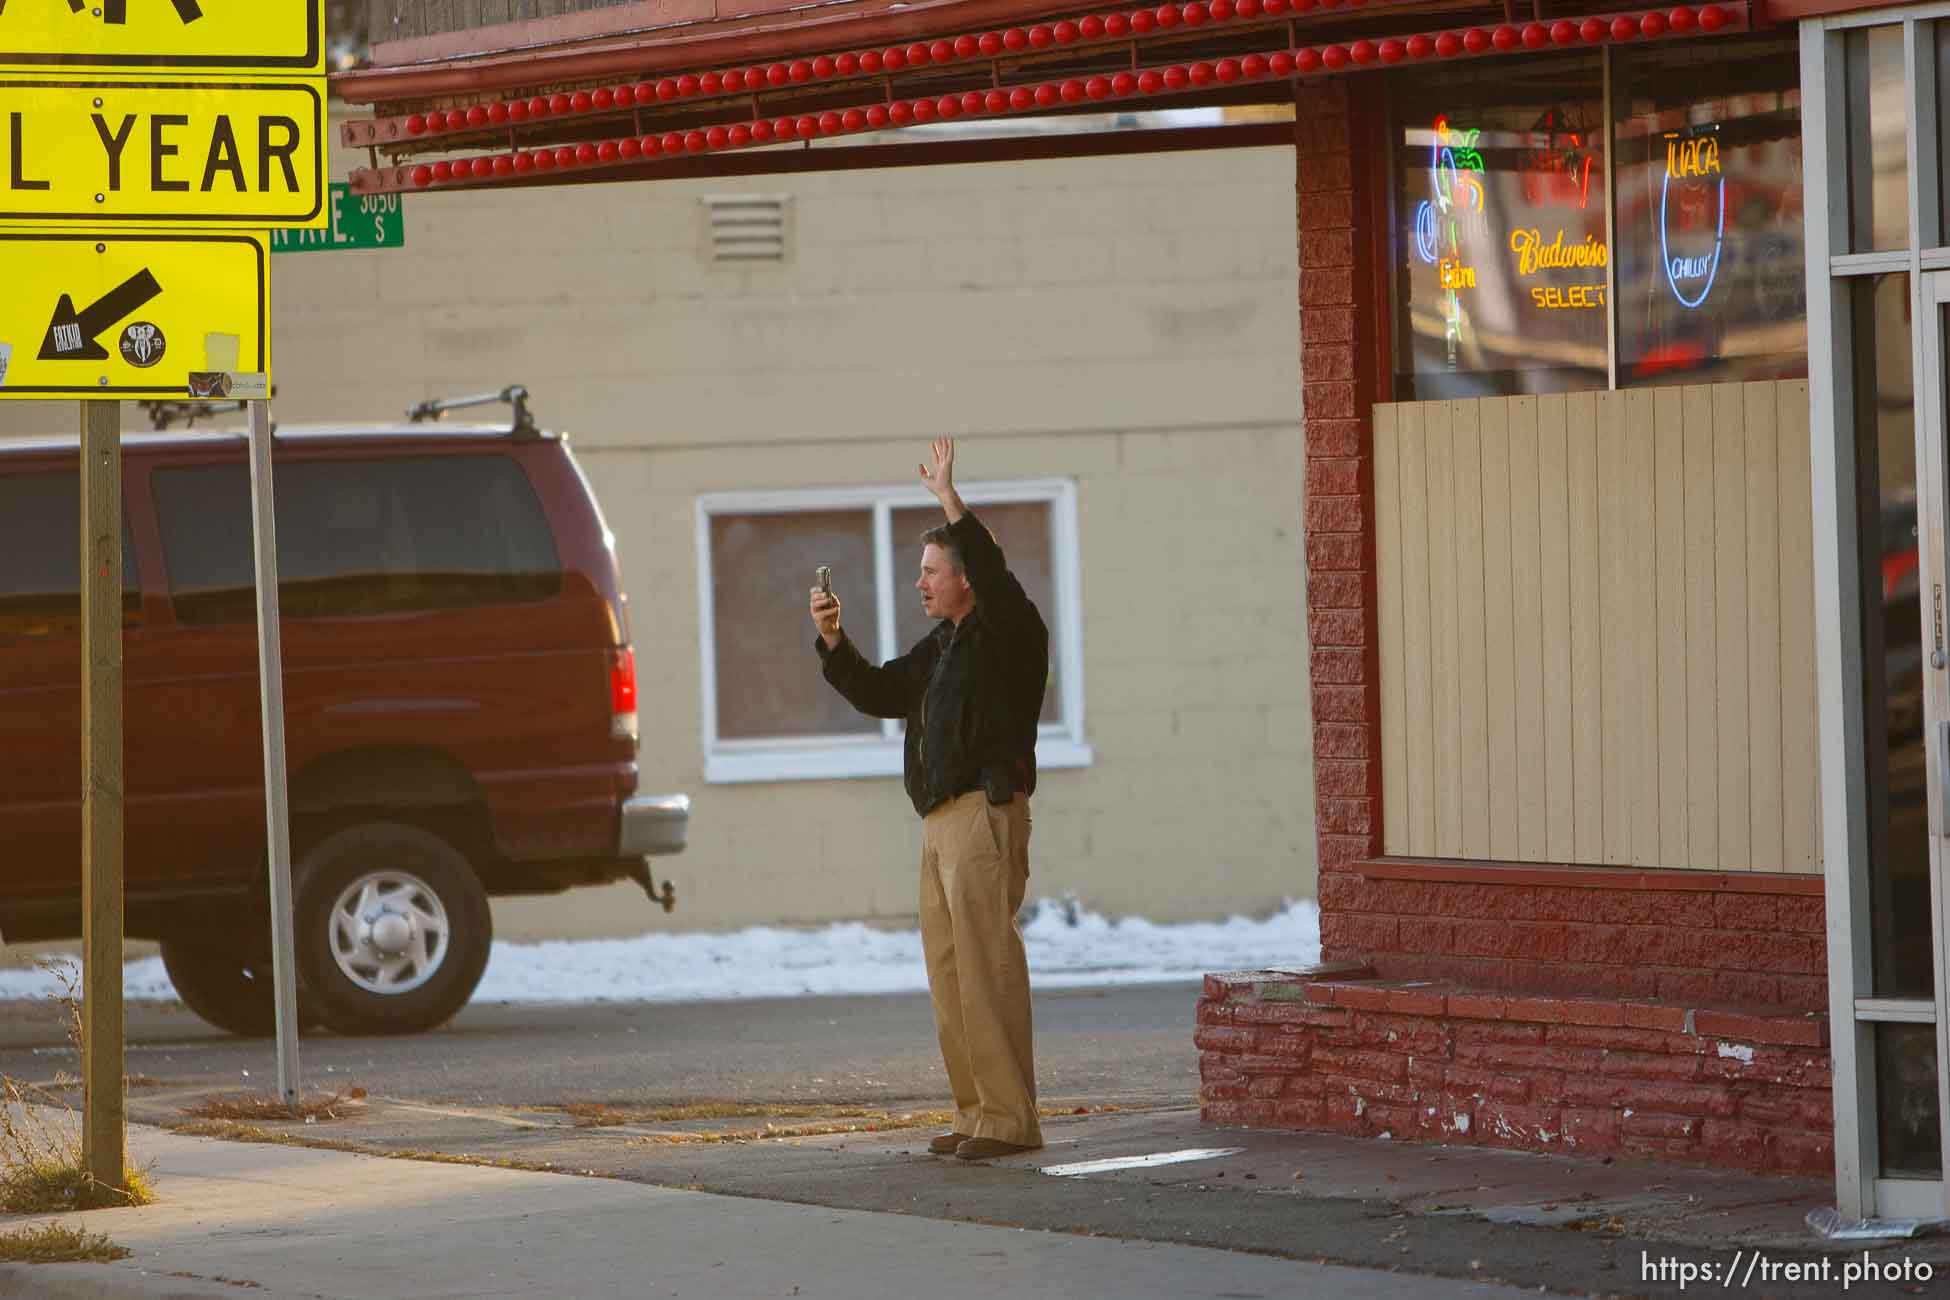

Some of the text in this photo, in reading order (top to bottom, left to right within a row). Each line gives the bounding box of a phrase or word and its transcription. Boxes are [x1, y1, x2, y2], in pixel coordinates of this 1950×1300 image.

[90, 114, 300, 193] YEAR
[1664, 133, 1720, 178] TUACA
[375, 216, 385, 243] S
[1531, 284, 1608, 308] SELECT
